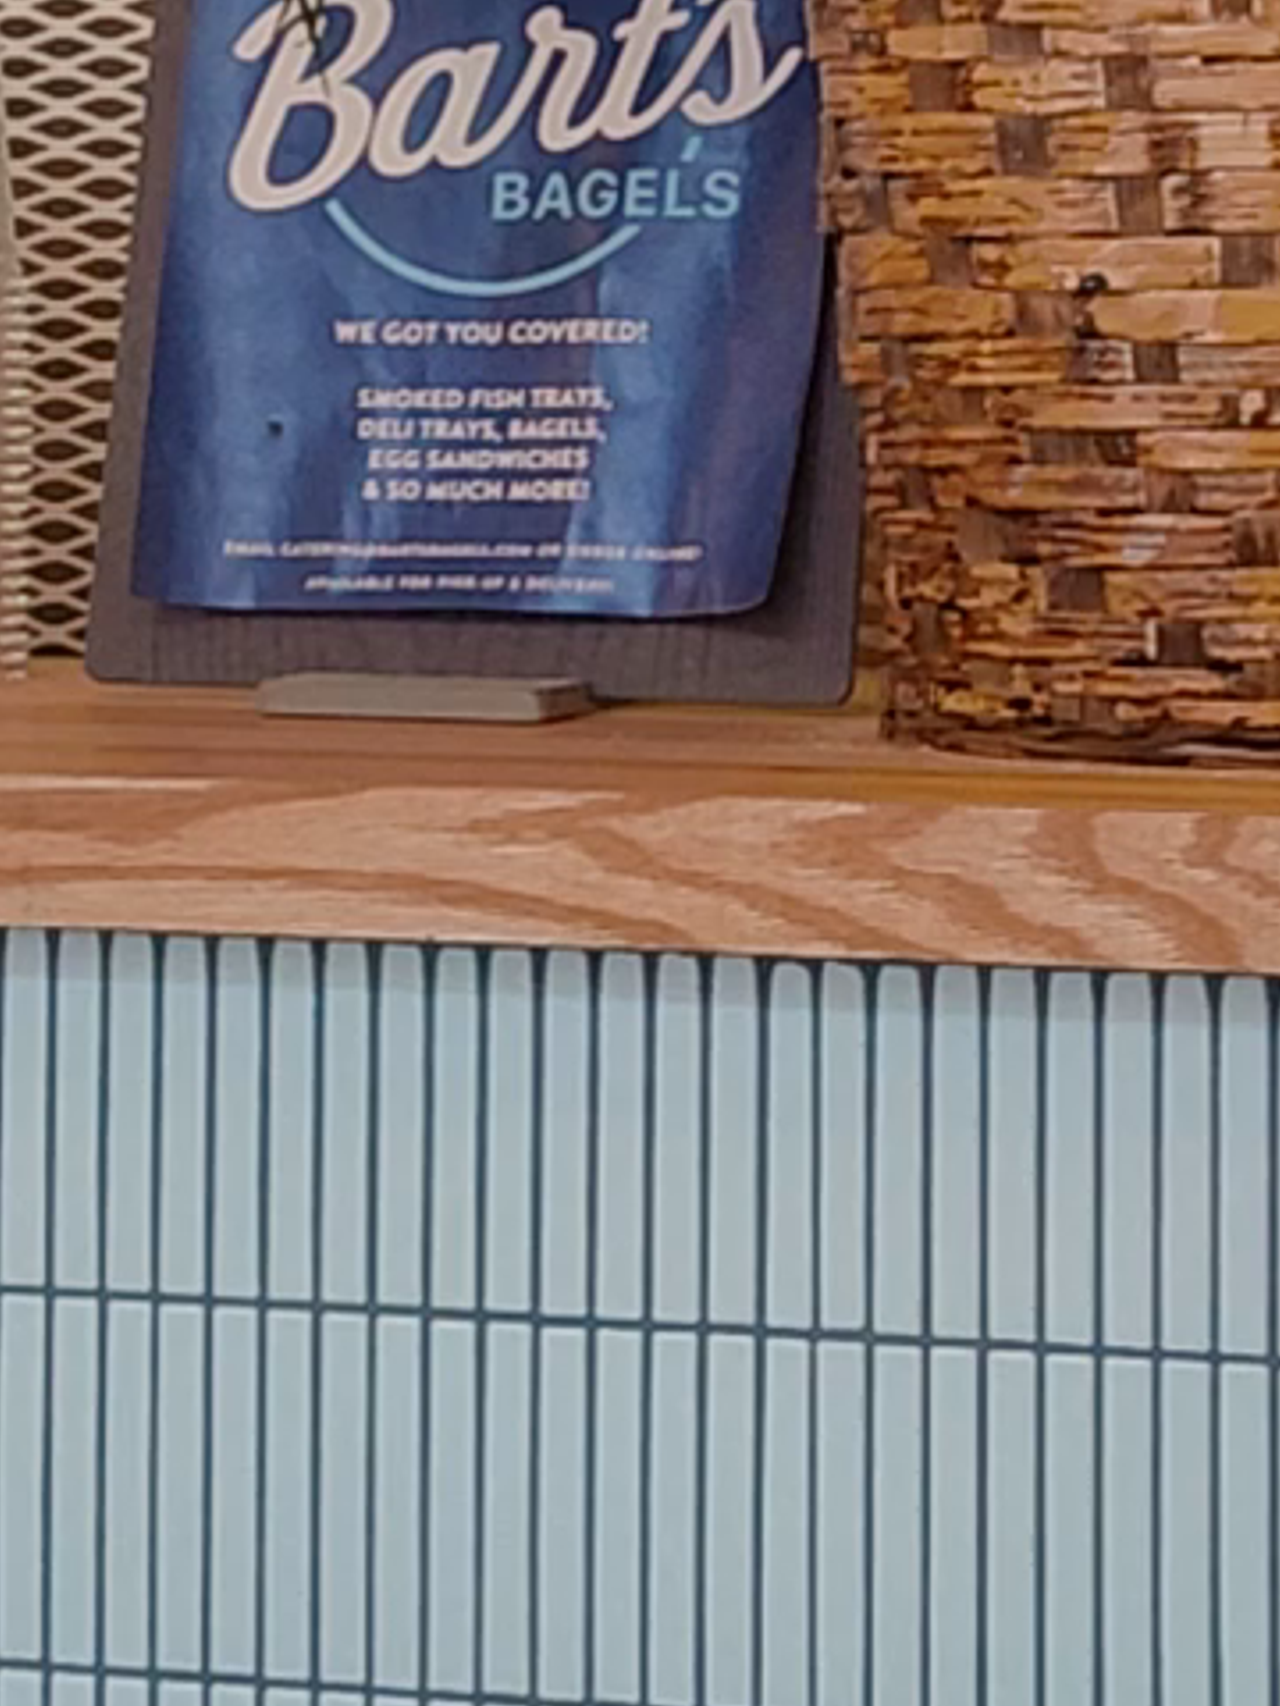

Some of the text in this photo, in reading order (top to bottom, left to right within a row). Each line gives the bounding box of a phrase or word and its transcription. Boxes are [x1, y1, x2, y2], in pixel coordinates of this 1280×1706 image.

[492, 167, 741, 223] BAGELS
[335, 319, 650, 344] WE GOT YOU COVERED!
[357, 389, 613, 411] SMOKED FISH TRAYS,
[357, 418, 607, 443] DELI TRAYS, BAGELS,
[369, 447, 589, 469] EGG SANDWICHES
[362, 479, 590, 500] & SO MUCH MORE!
